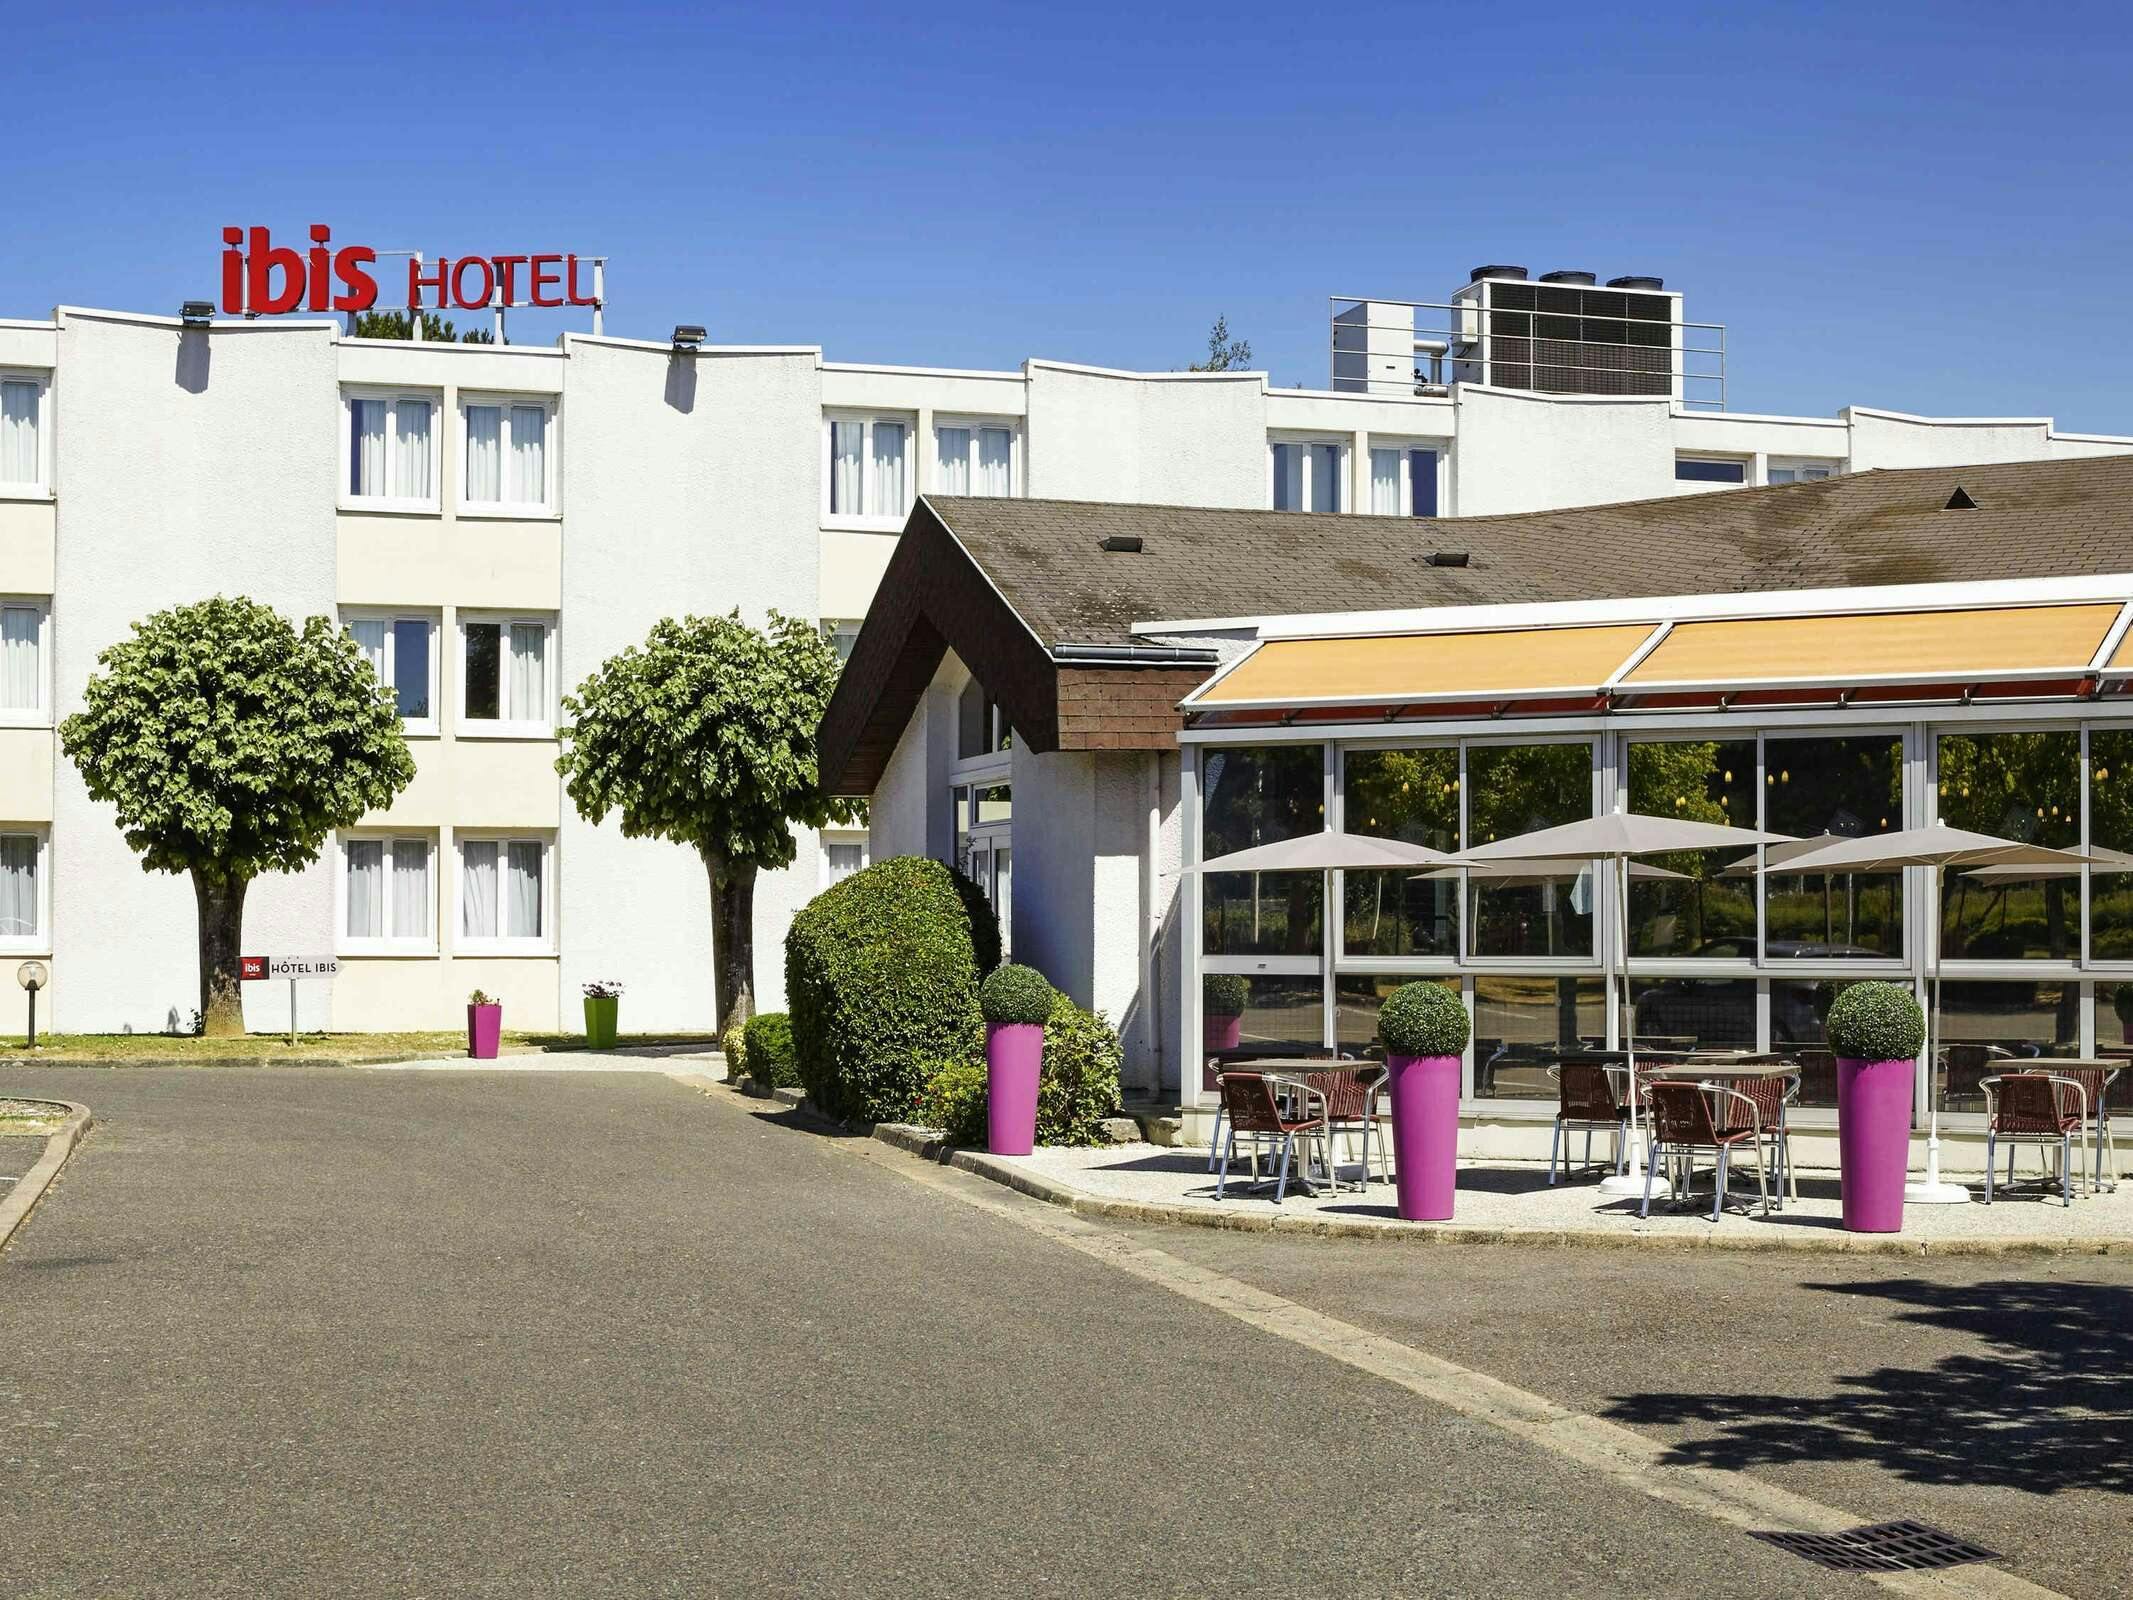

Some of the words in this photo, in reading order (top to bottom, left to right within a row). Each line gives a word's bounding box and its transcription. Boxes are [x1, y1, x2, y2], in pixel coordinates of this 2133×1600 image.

[222, 224, 378, 315] ibis
[408, 253, 598, 311] HOTEL
[245, 963, 260, 972] ibis
[271, 961, 311, 973] HÔTEL
[315, 963, 337, 972] IBIS
